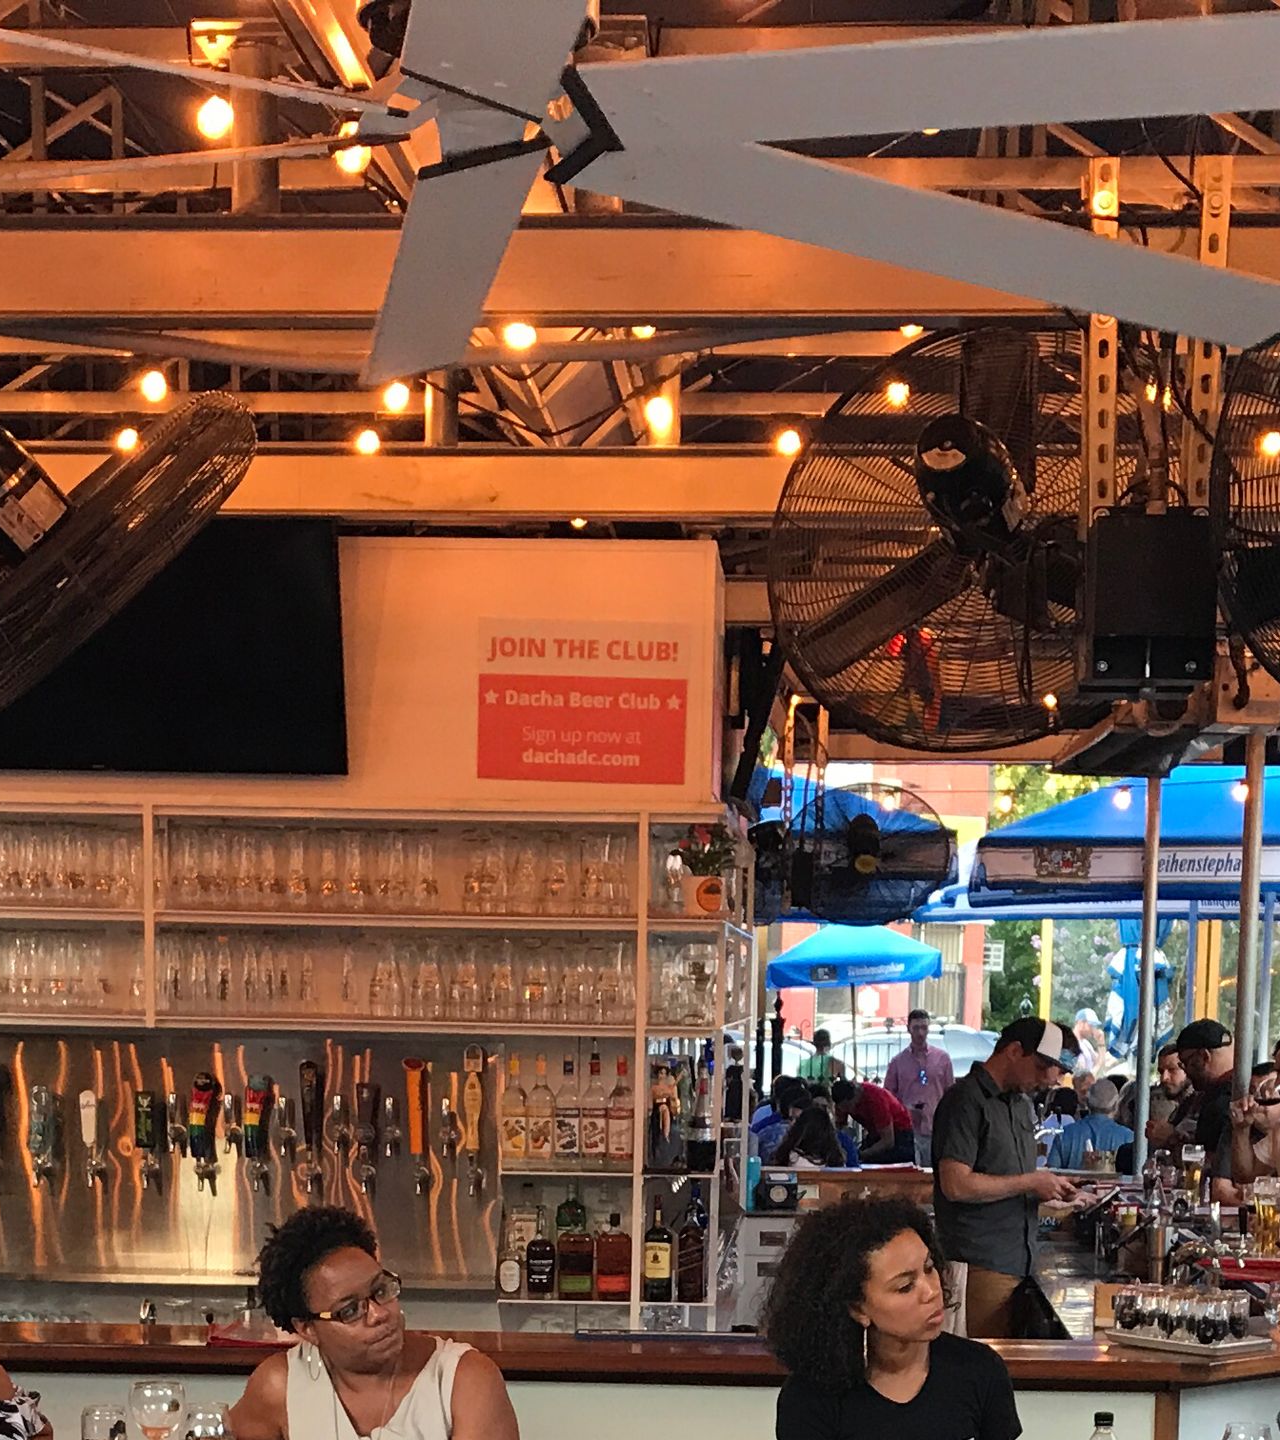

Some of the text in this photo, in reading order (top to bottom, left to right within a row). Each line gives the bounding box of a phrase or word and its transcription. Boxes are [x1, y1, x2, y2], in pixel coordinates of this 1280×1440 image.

[487, 636, 679, 663] JOIN THE CLUB!
[504, 689, 661, 711] Dacha Beer Club
[521, 725, 642, 748] Sign up now at
[521, 747, 641, 767] dachadc.com
[1157, 852, 1242, 876] eihenstepha
